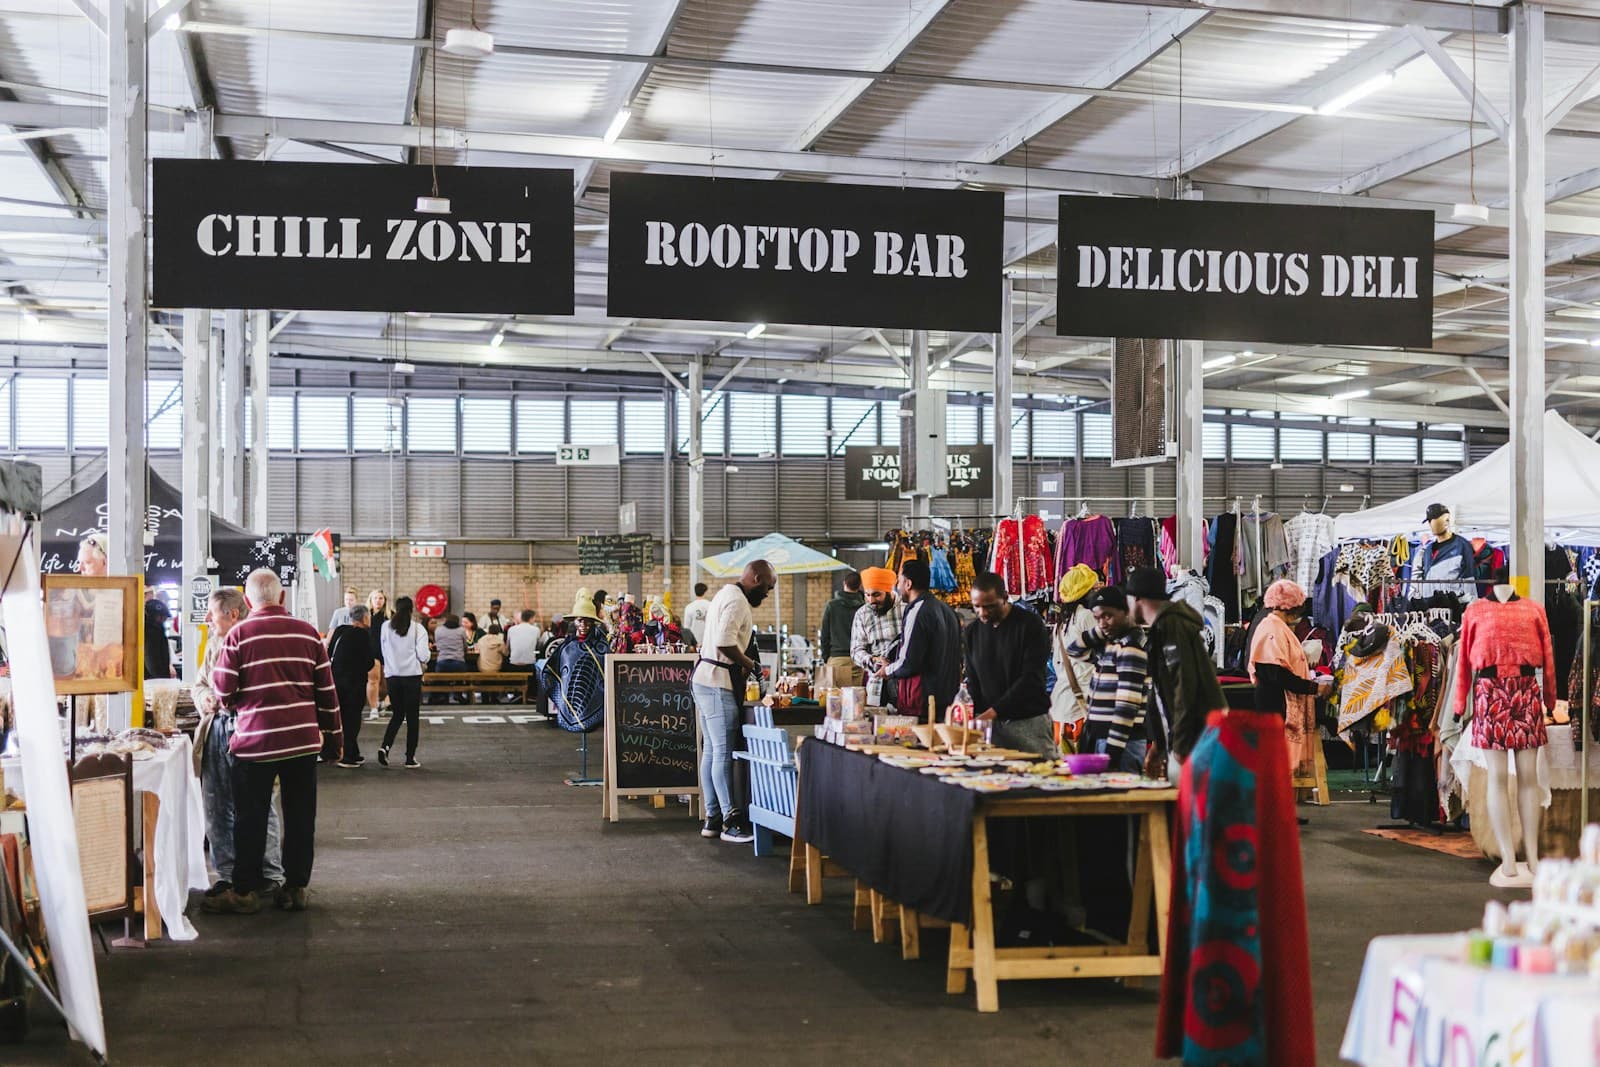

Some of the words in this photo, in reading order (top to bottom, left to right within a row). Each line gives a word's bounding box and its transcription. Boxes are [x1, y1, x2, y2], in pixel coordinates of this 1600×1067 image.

[197, 213, 371, 260] CHILL
[386, 219, 532, 263] ZONE
[645, 221, 860, 273] ROOFTOP
[873, 231, 968, 279] BAR
[1077, 245, 1309, 297] DELICIOUS
[1321, 254, 1419, 299] DELI
[862, 468, 900, 480] FOO
